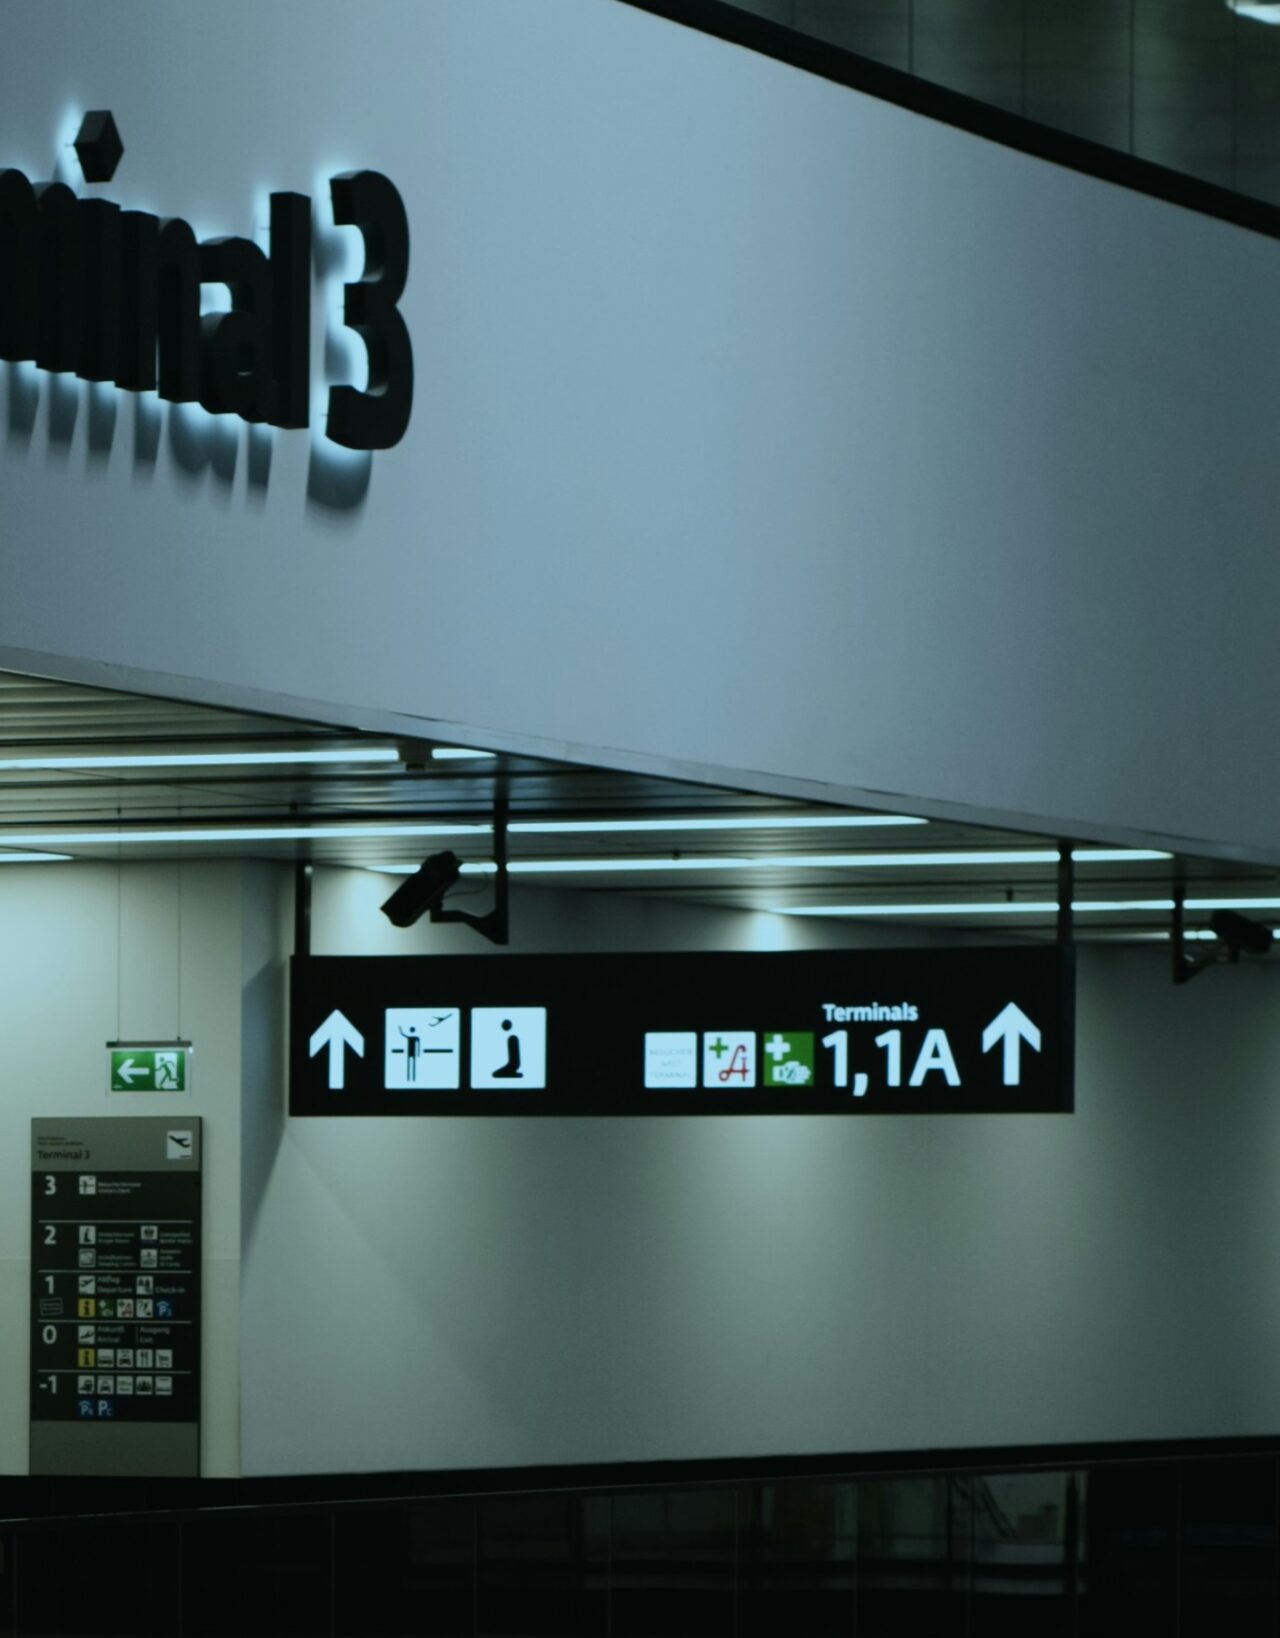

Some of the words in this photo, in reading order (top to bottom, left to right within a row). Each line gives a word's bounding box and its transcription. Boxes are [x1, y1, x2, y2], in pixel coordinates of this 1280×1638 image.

[326, 170, 414, 450] 3
[822, 1002, 918, 1022] Terminals
[37, 1149, 82, 1160] Terminal
[85, 1150, 90, 1160] 3
[44, 1175, 56, 1195] 3
[44, 1225, 56, 1245] 2
[44, 1275, 55, 1295] 1
[42, 1325, 57, 1345] 0
[39, 1375, 57, 1394] -1
